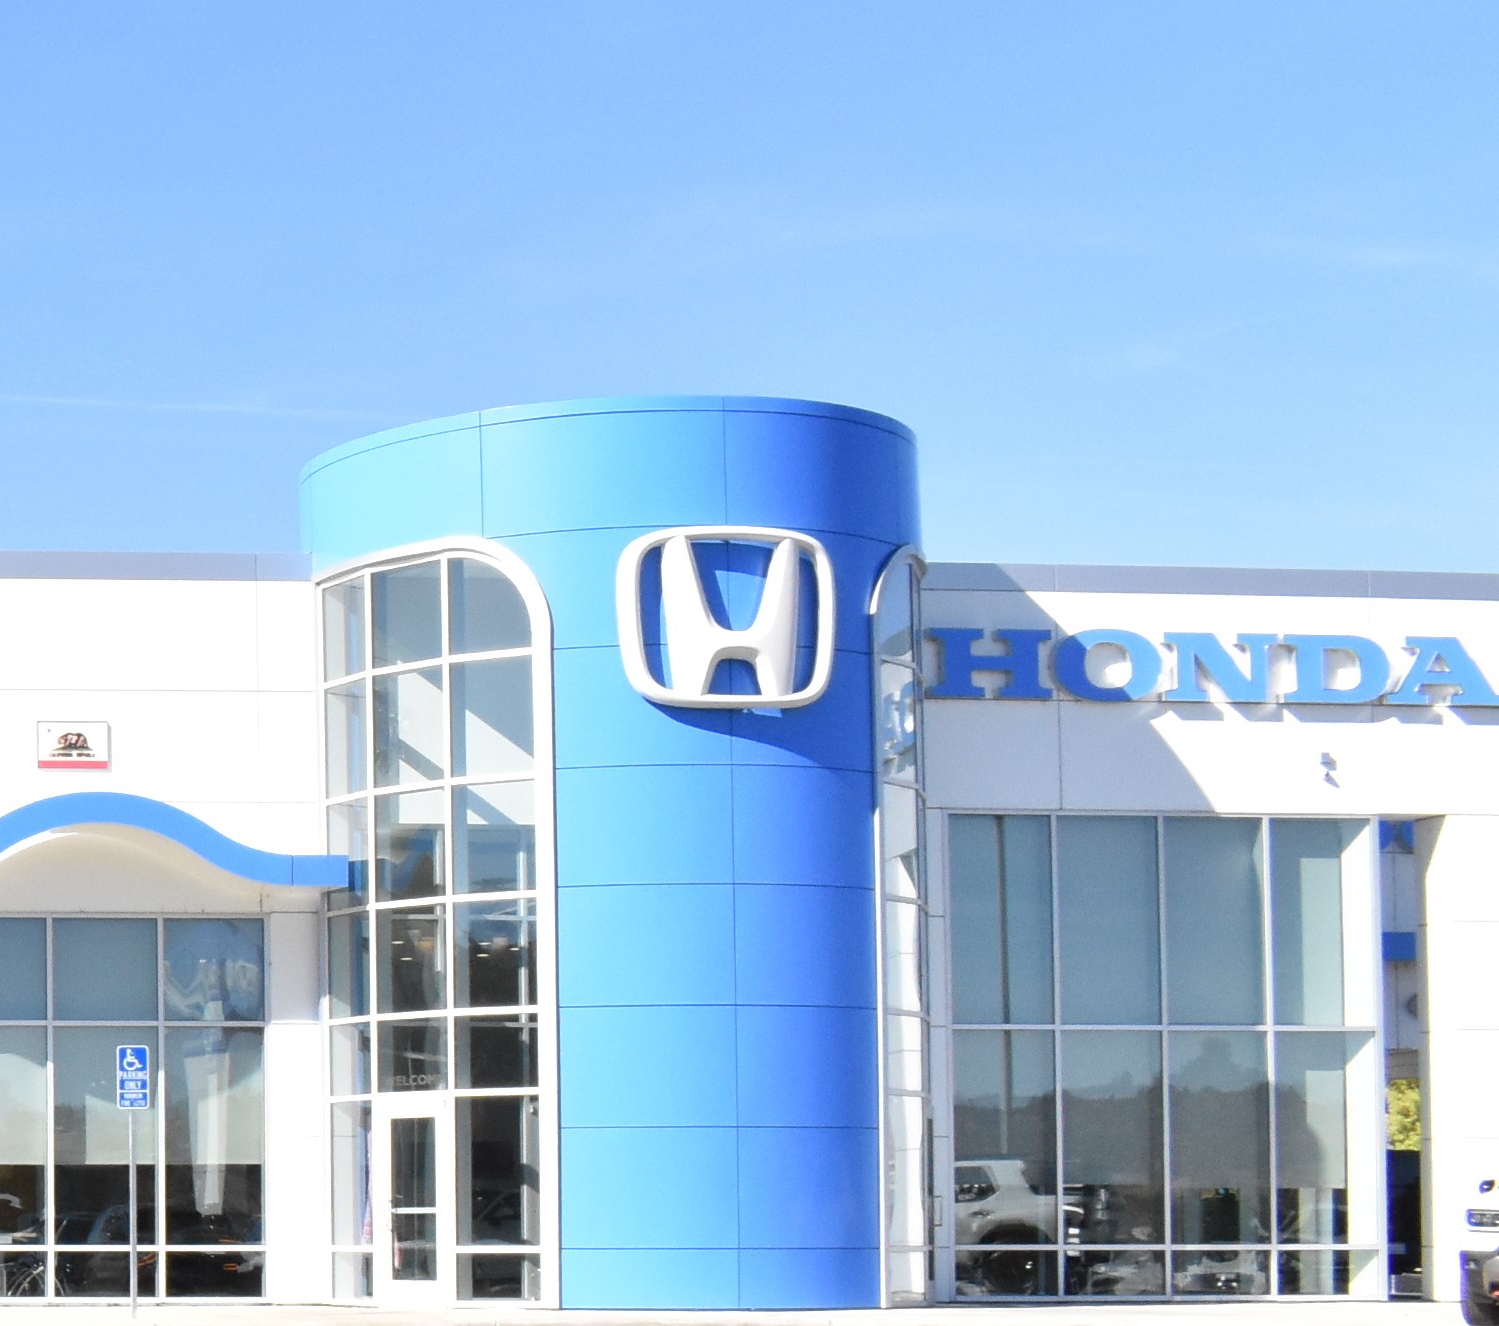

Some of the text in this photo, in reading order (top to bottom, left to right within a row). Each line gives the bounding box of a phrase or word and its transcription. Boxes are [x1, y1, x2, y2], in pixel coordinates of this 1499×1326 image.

[924, 627, 1499, 706] HONDA
[118, 1070, 147, 1080] PARKING
[124, 1080, 142, 1090] ONLY
